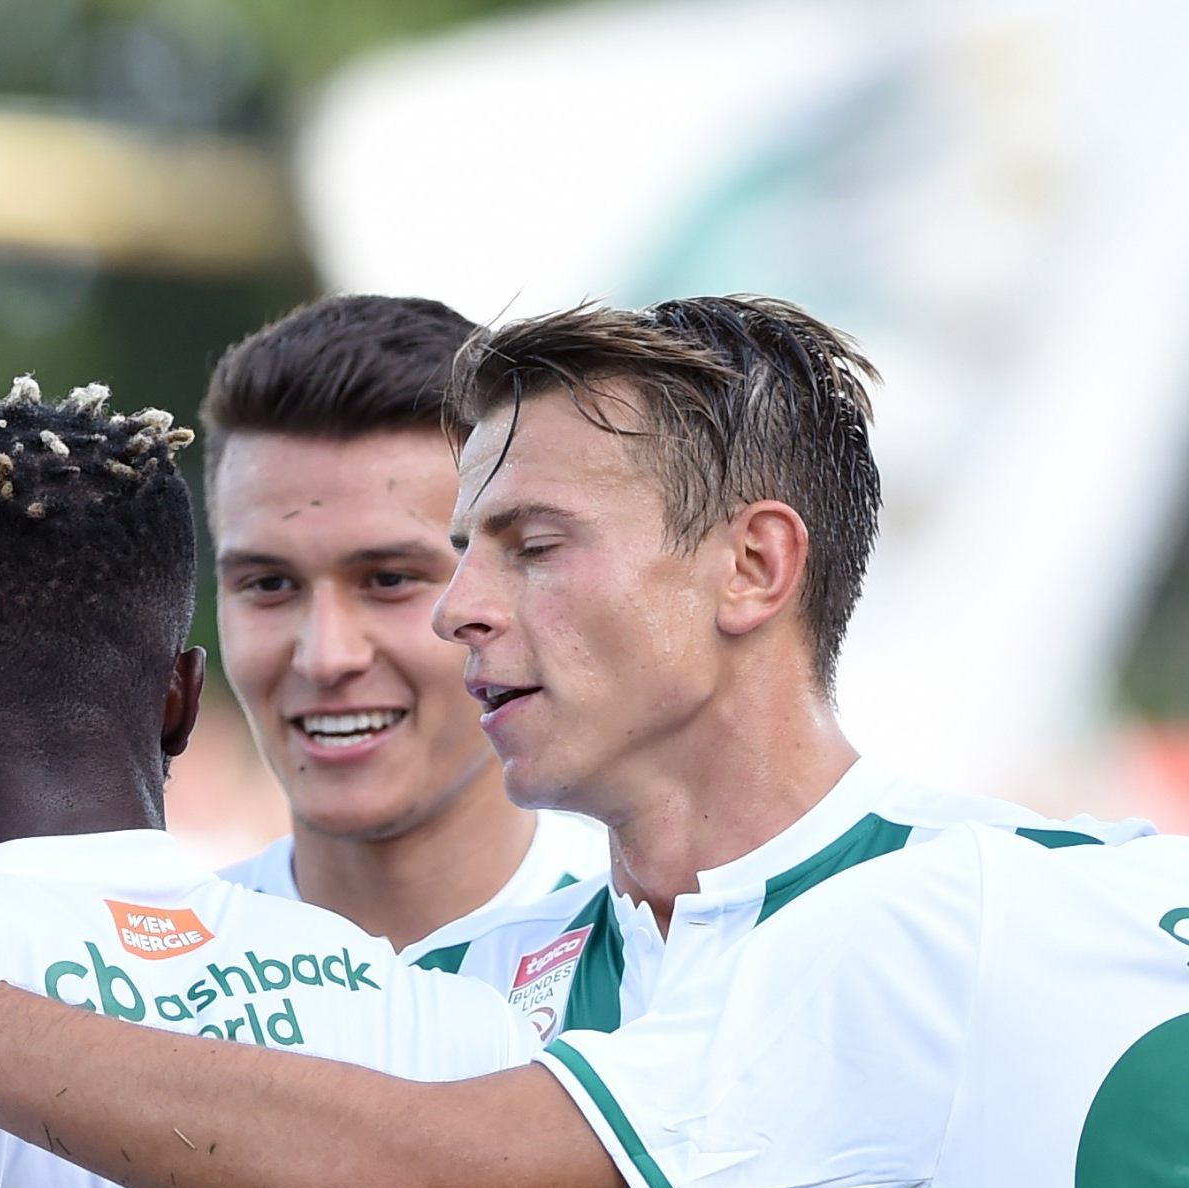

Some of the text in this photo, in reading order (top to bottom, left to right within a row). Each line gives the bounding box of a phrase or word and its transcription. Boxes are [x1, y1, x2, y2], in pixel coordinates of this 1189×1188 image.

[127, 912, 176, 934] WIEN
[121, 928, 204, 952] ENERGIE
[153, 946, 382, 1021] ashback
[512, 965, 572, 1005] BUNDES
[522, 987, 554, 1012] LIGA
[198, 998, 304, 1047] rld
